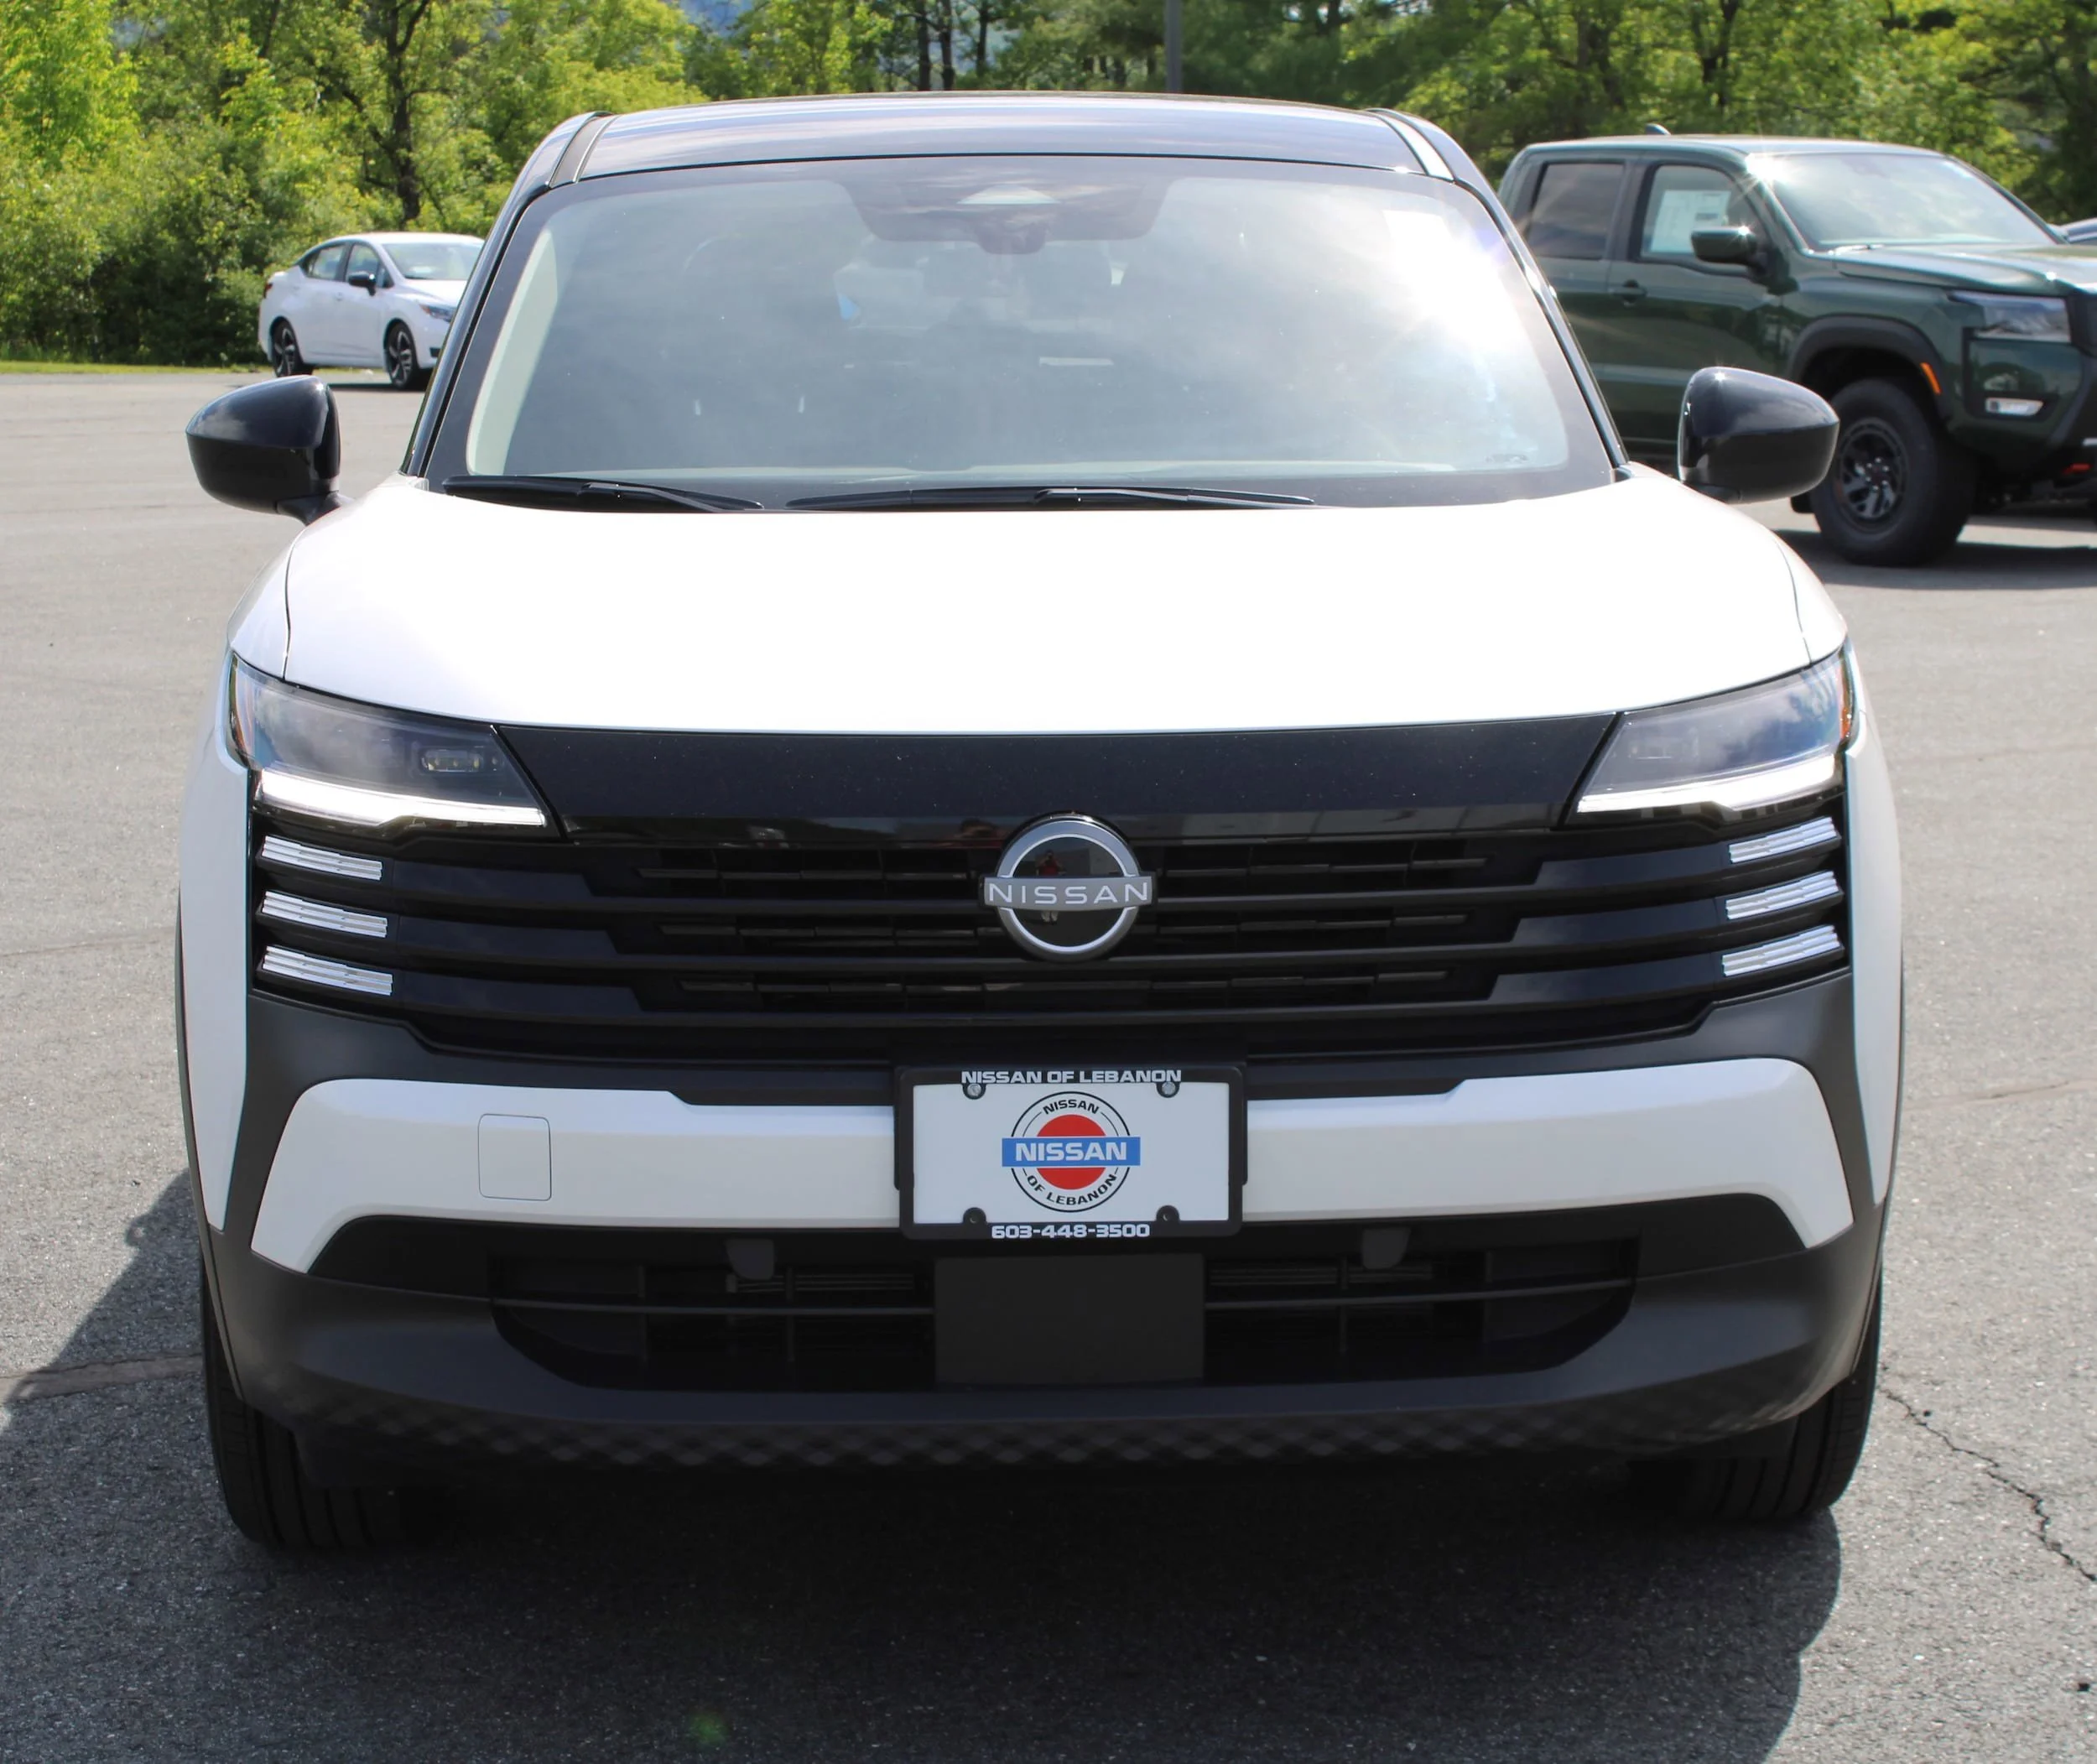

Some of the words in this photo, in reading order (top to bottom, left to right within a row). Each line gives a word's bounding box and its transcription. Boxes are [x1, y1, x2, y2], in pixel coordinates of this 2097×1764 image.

[989, 882, 1147, 905] NISSAN
[961, 1070, 1043, 1084] NISSAN
[1047, 1070, 1075, 1083] OF
[1079, 1069, 1182, 1083] LEBANON
[1043, 1099, 1100, 1115] NISSAN
[1015, 1142, 1127, 1162] NISSAN
[1026, 1174, 1046, 1192] OF
[1046, 1173, 1118, 1206] LEBANON
[991, 1224, 1151, 1239] 603-448-3500
